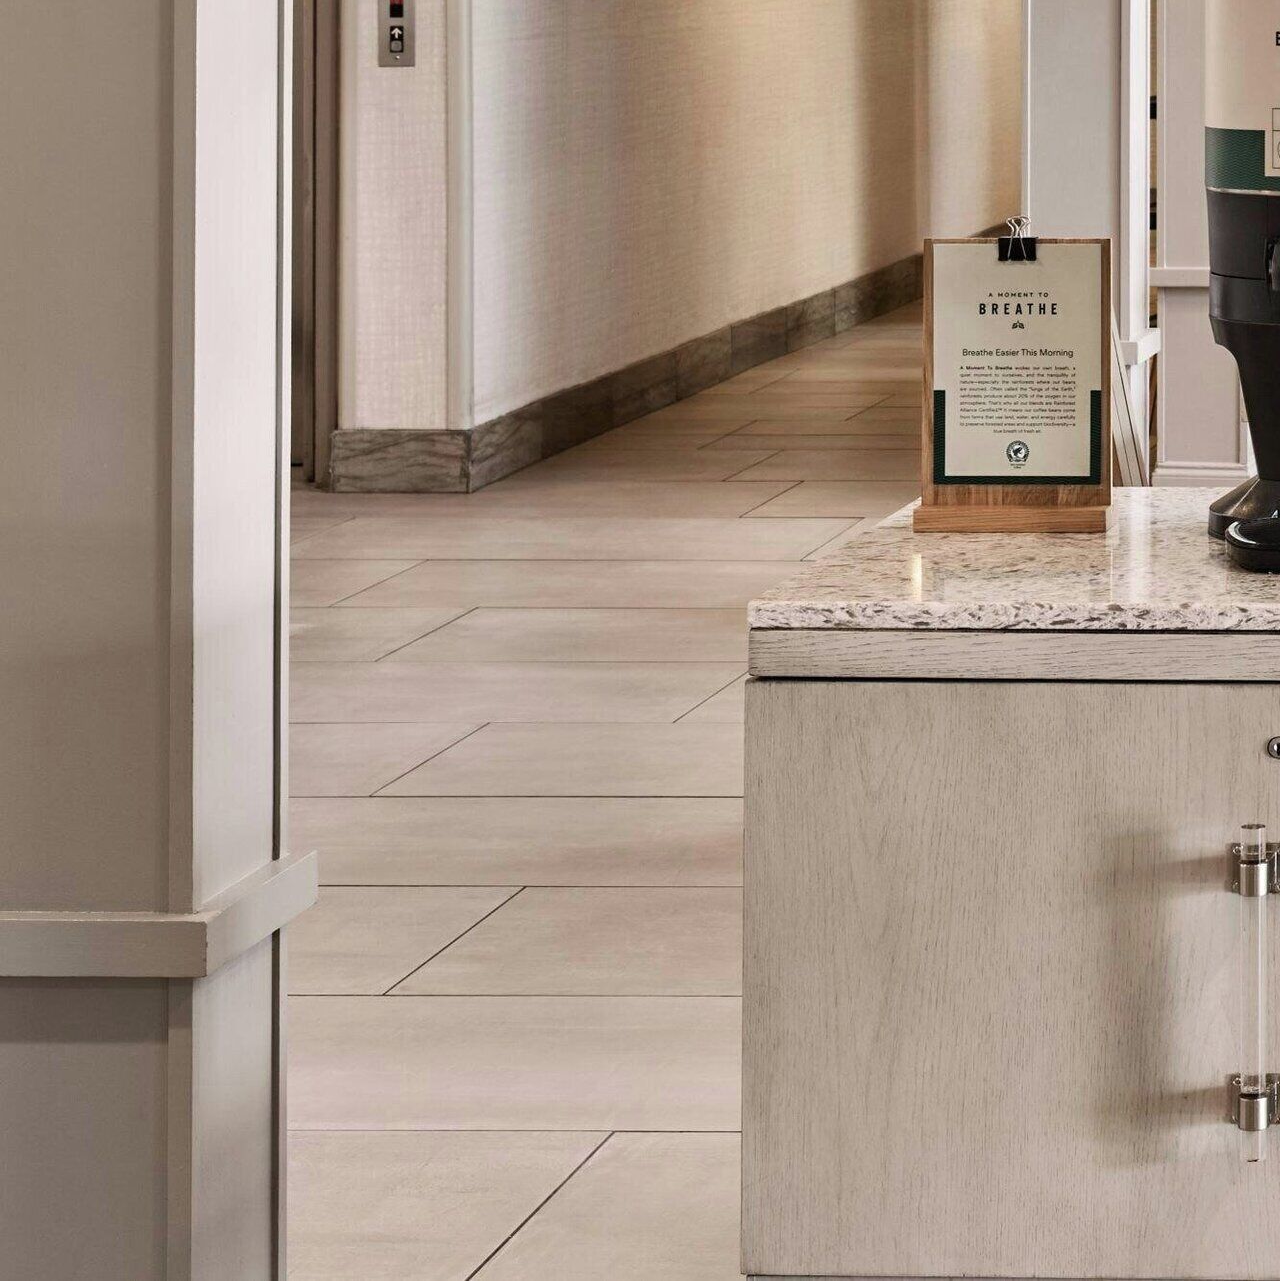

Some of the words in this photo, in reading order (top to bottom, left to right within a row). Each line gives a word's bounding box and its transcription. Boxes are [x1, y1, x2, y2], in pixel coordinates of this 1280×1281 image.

[979, 303, 1058, 315] BREATHE
[962, 348, 994, 357] Breathe
[995, 348, 1020, 357] Easier
[1021, 348, 1038, 357] This
[1039, 348, 1074, 359] Morning
